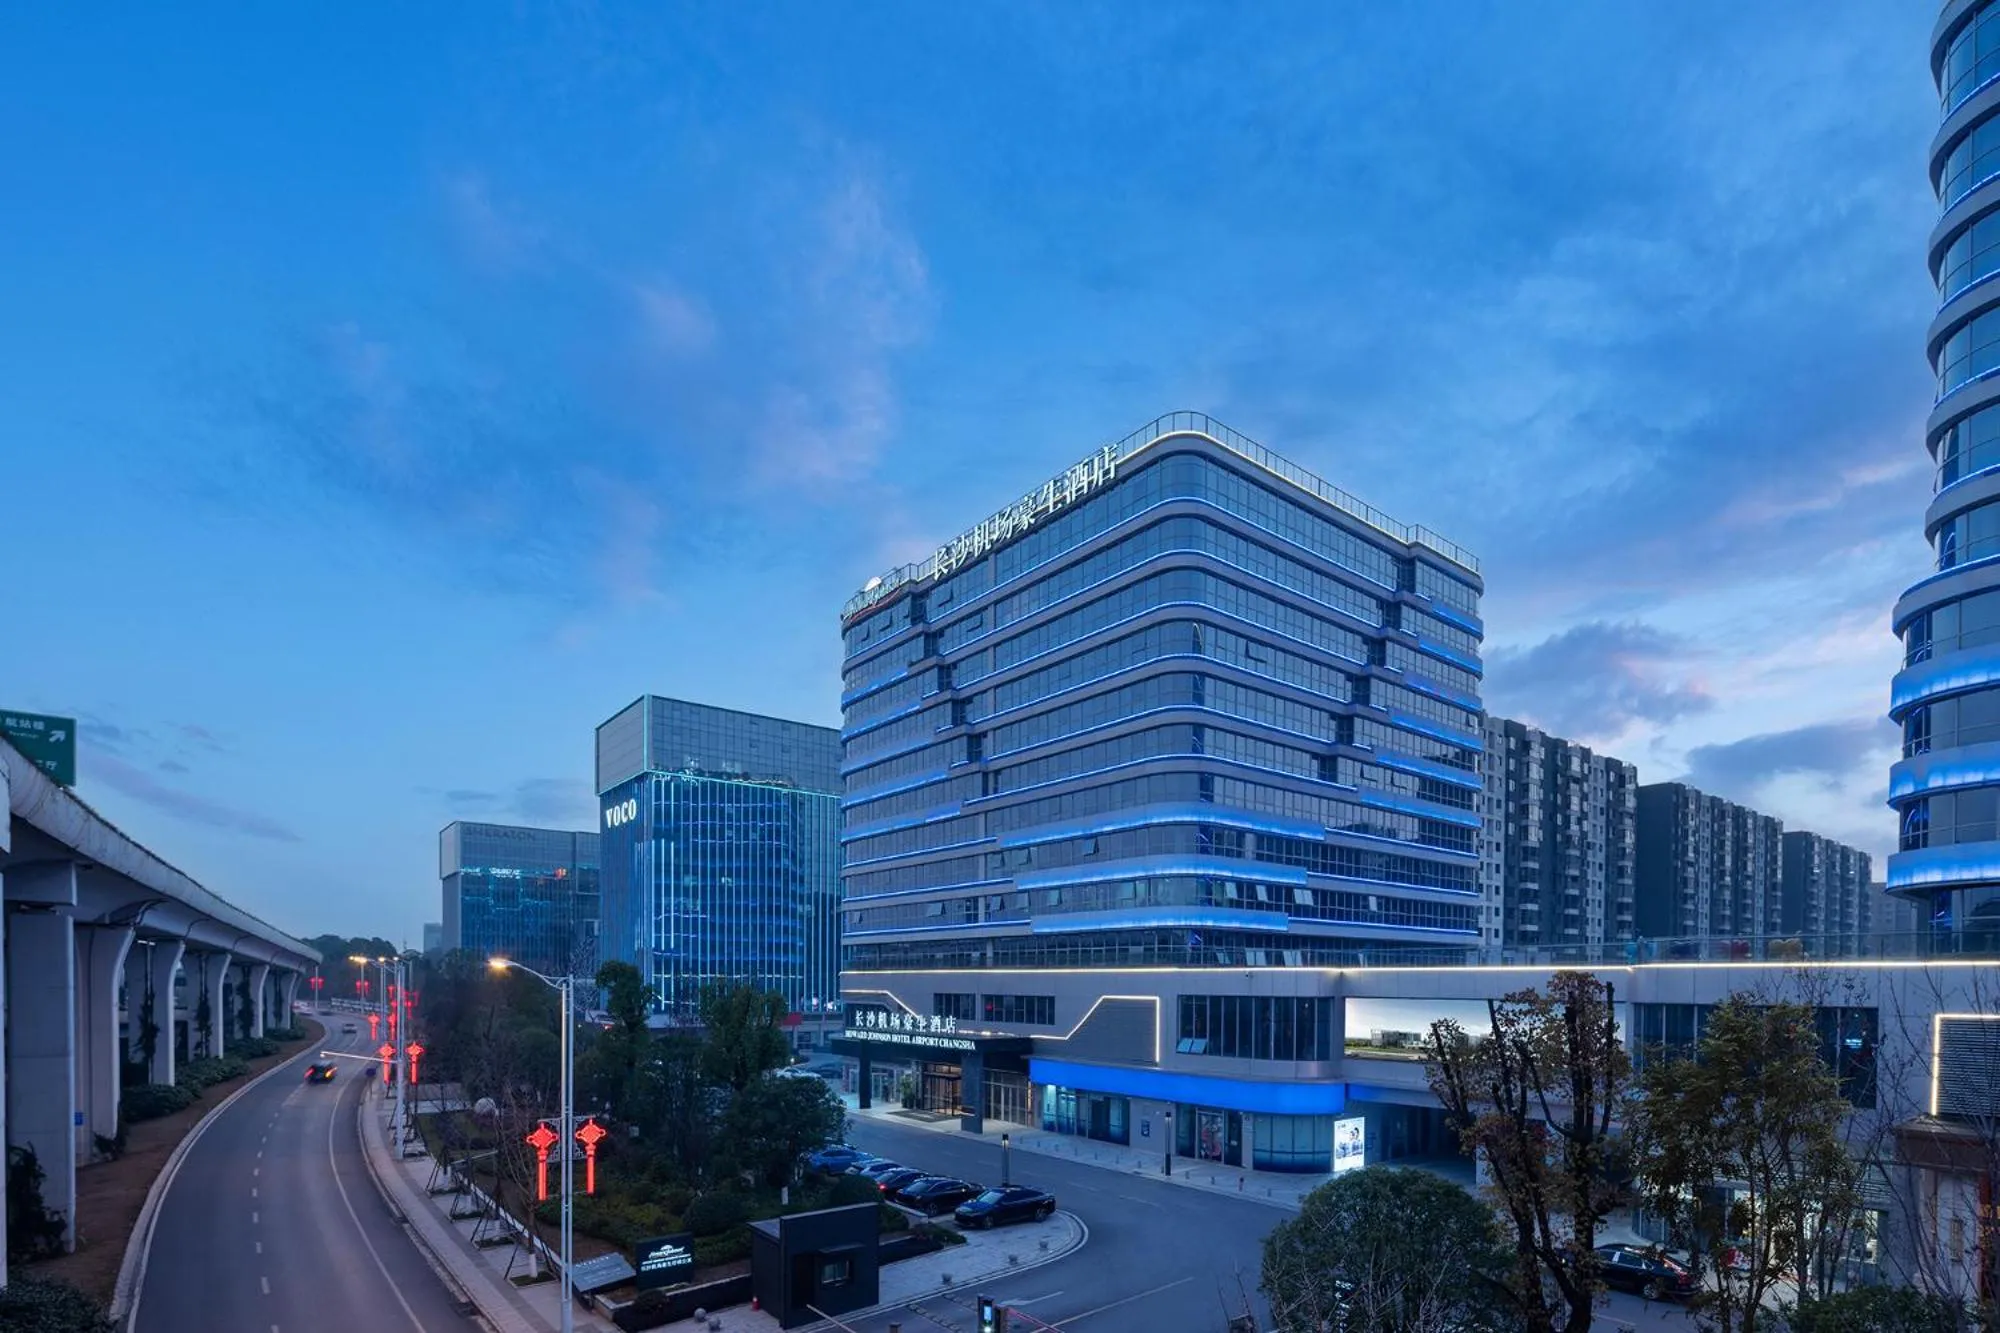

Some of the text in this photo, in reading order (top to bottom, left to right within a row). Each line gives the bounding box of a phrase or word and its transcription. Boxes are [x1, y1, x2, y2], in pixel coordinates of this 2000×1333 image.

[933, 444, 1118, 581] 长沙机场豪生酒店
[891, 1033, 910, 1044] HOTEL
[911, 1035, 939, 1047] AIRPORT
[939, 1038, 976, 1050] CHANGSHA
